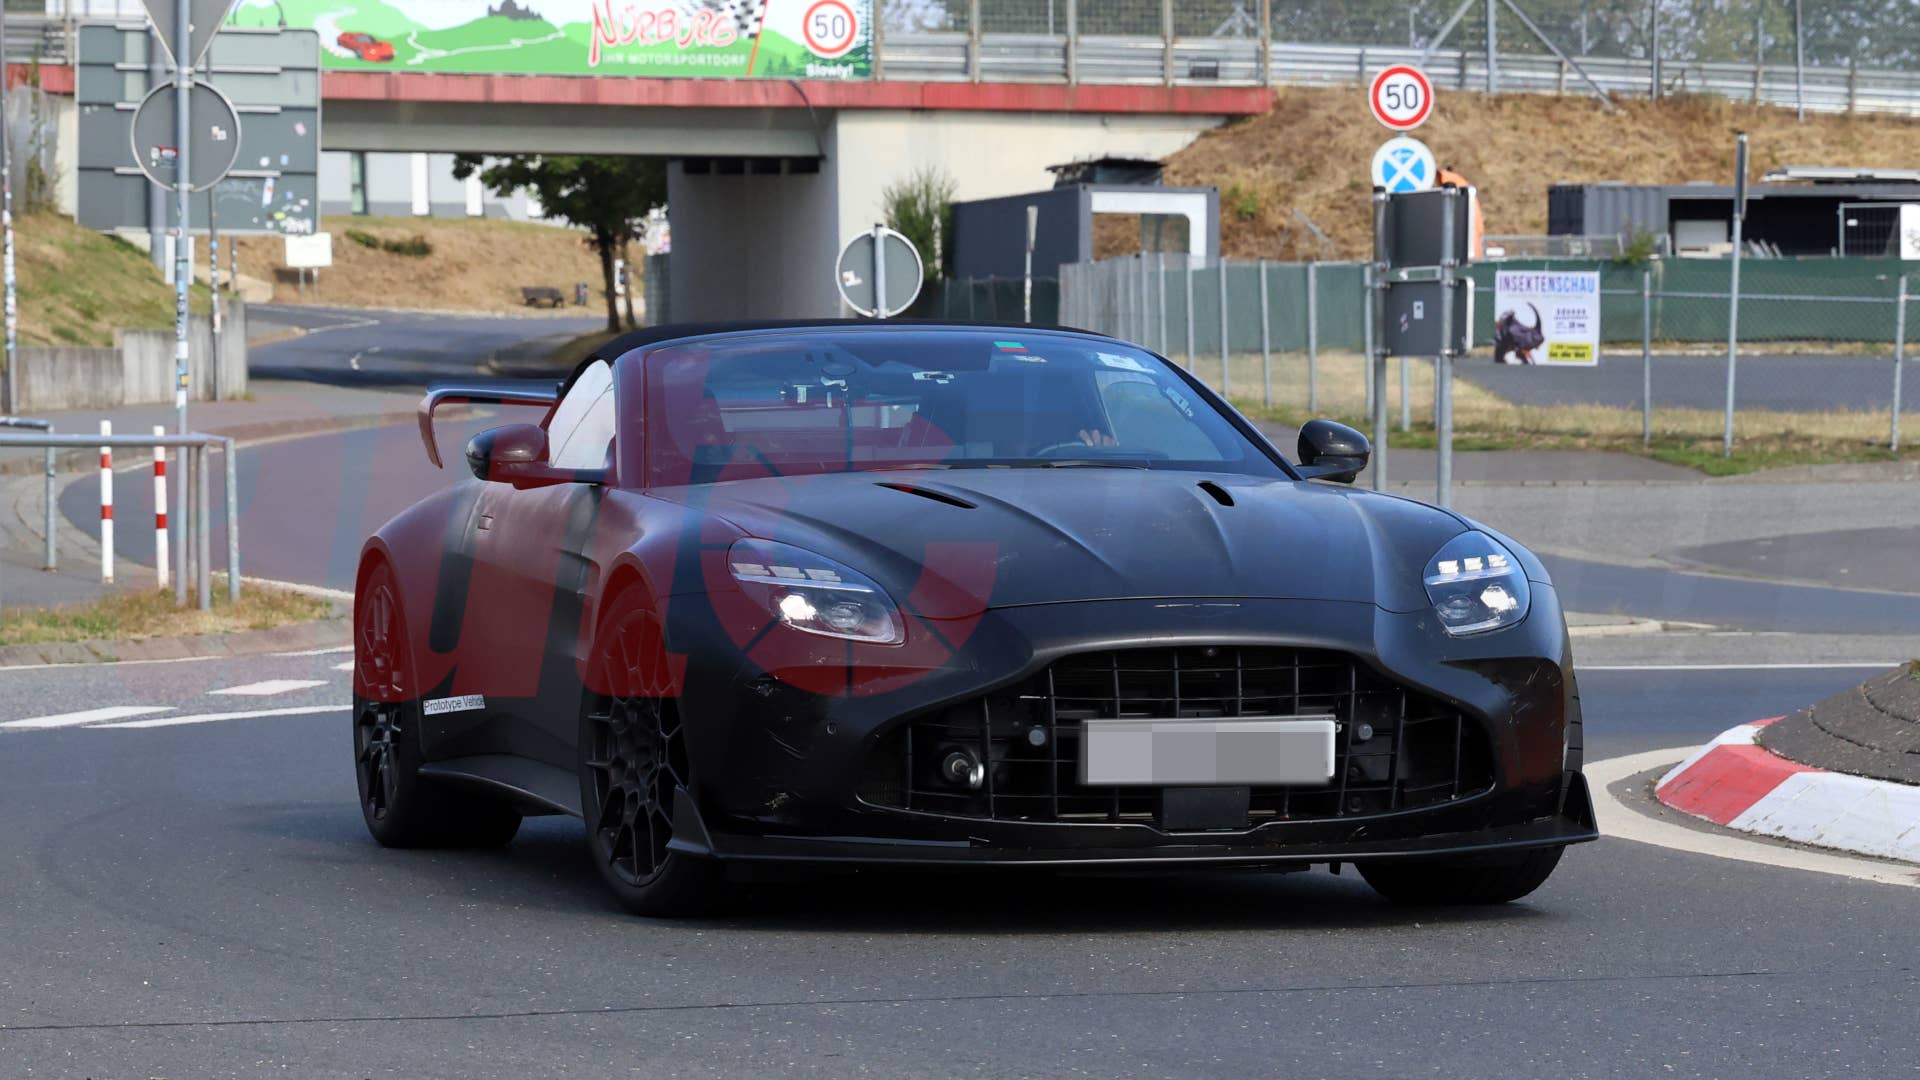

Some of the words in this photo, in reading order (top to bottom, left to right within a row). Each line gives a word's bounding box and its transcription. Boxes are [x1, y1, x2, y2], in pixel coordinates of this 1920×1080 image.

[589, 0, 738, 66] NÜRBURG
[815, 14, 845, 39] 50
[628, 53, 746, 67] MOTORSPORTDORF
[1386, 83, 1418, 110] 50
[1499, 274, 1595, 293] INSEKTENSCHAU
[423, 699, 462, 712] Prototype
